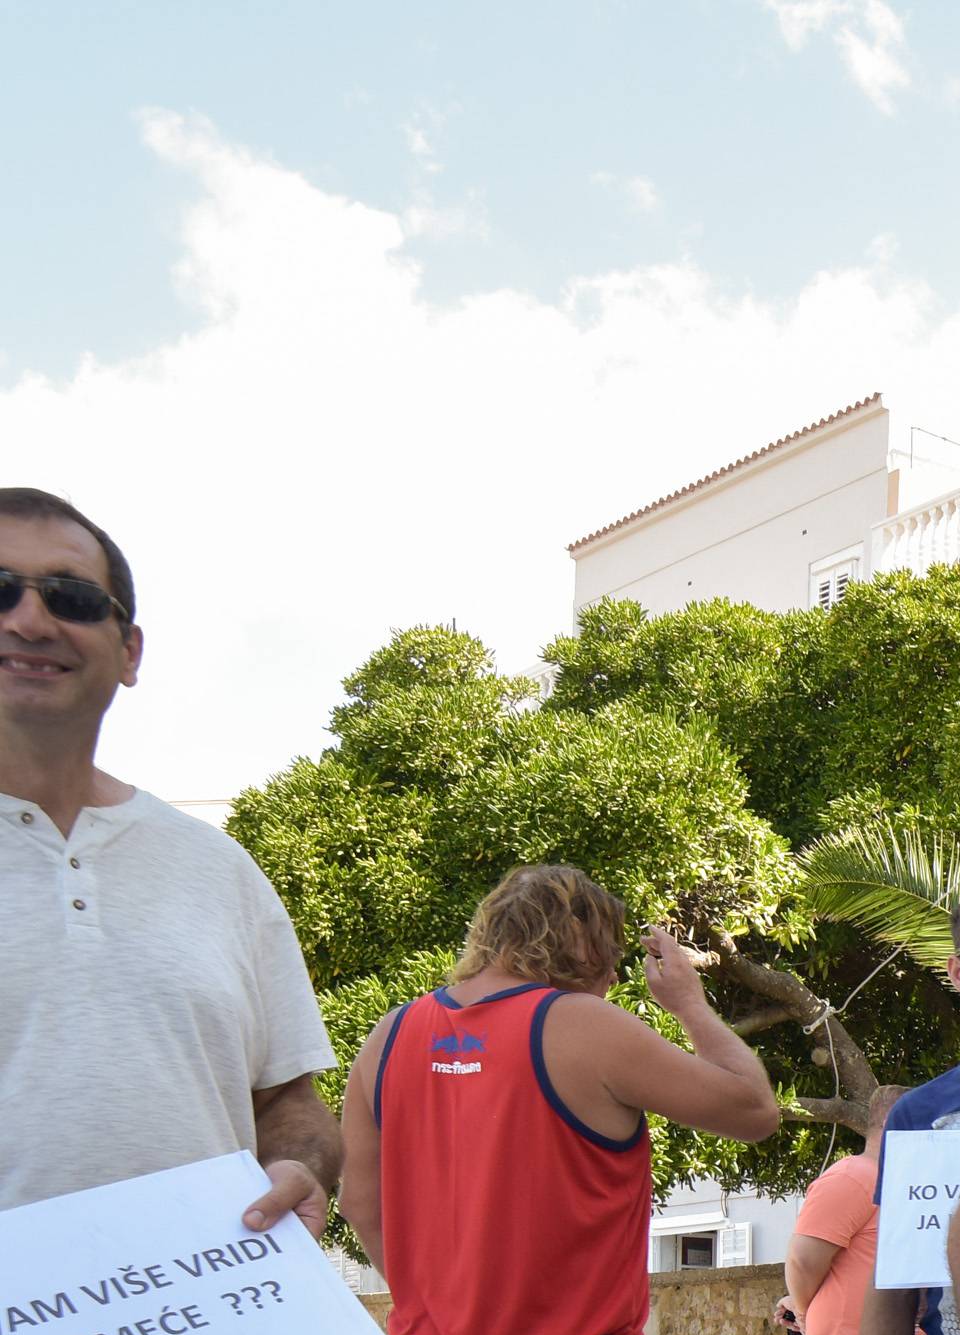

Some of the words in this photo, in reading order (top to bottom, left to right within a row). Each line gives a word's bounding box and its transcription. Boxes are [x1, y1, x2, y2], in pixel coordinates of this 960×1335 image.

[908, 1185, 938, 1200] KO
[916, 1214, 941, 1230] JA
[0, 1292, 79, 1335] AM
[80, 1265, 173, 1306] VIŠE
[173, 1233, 283, 1278] VRIDI
[221, 1281, 285, 1317] ???
